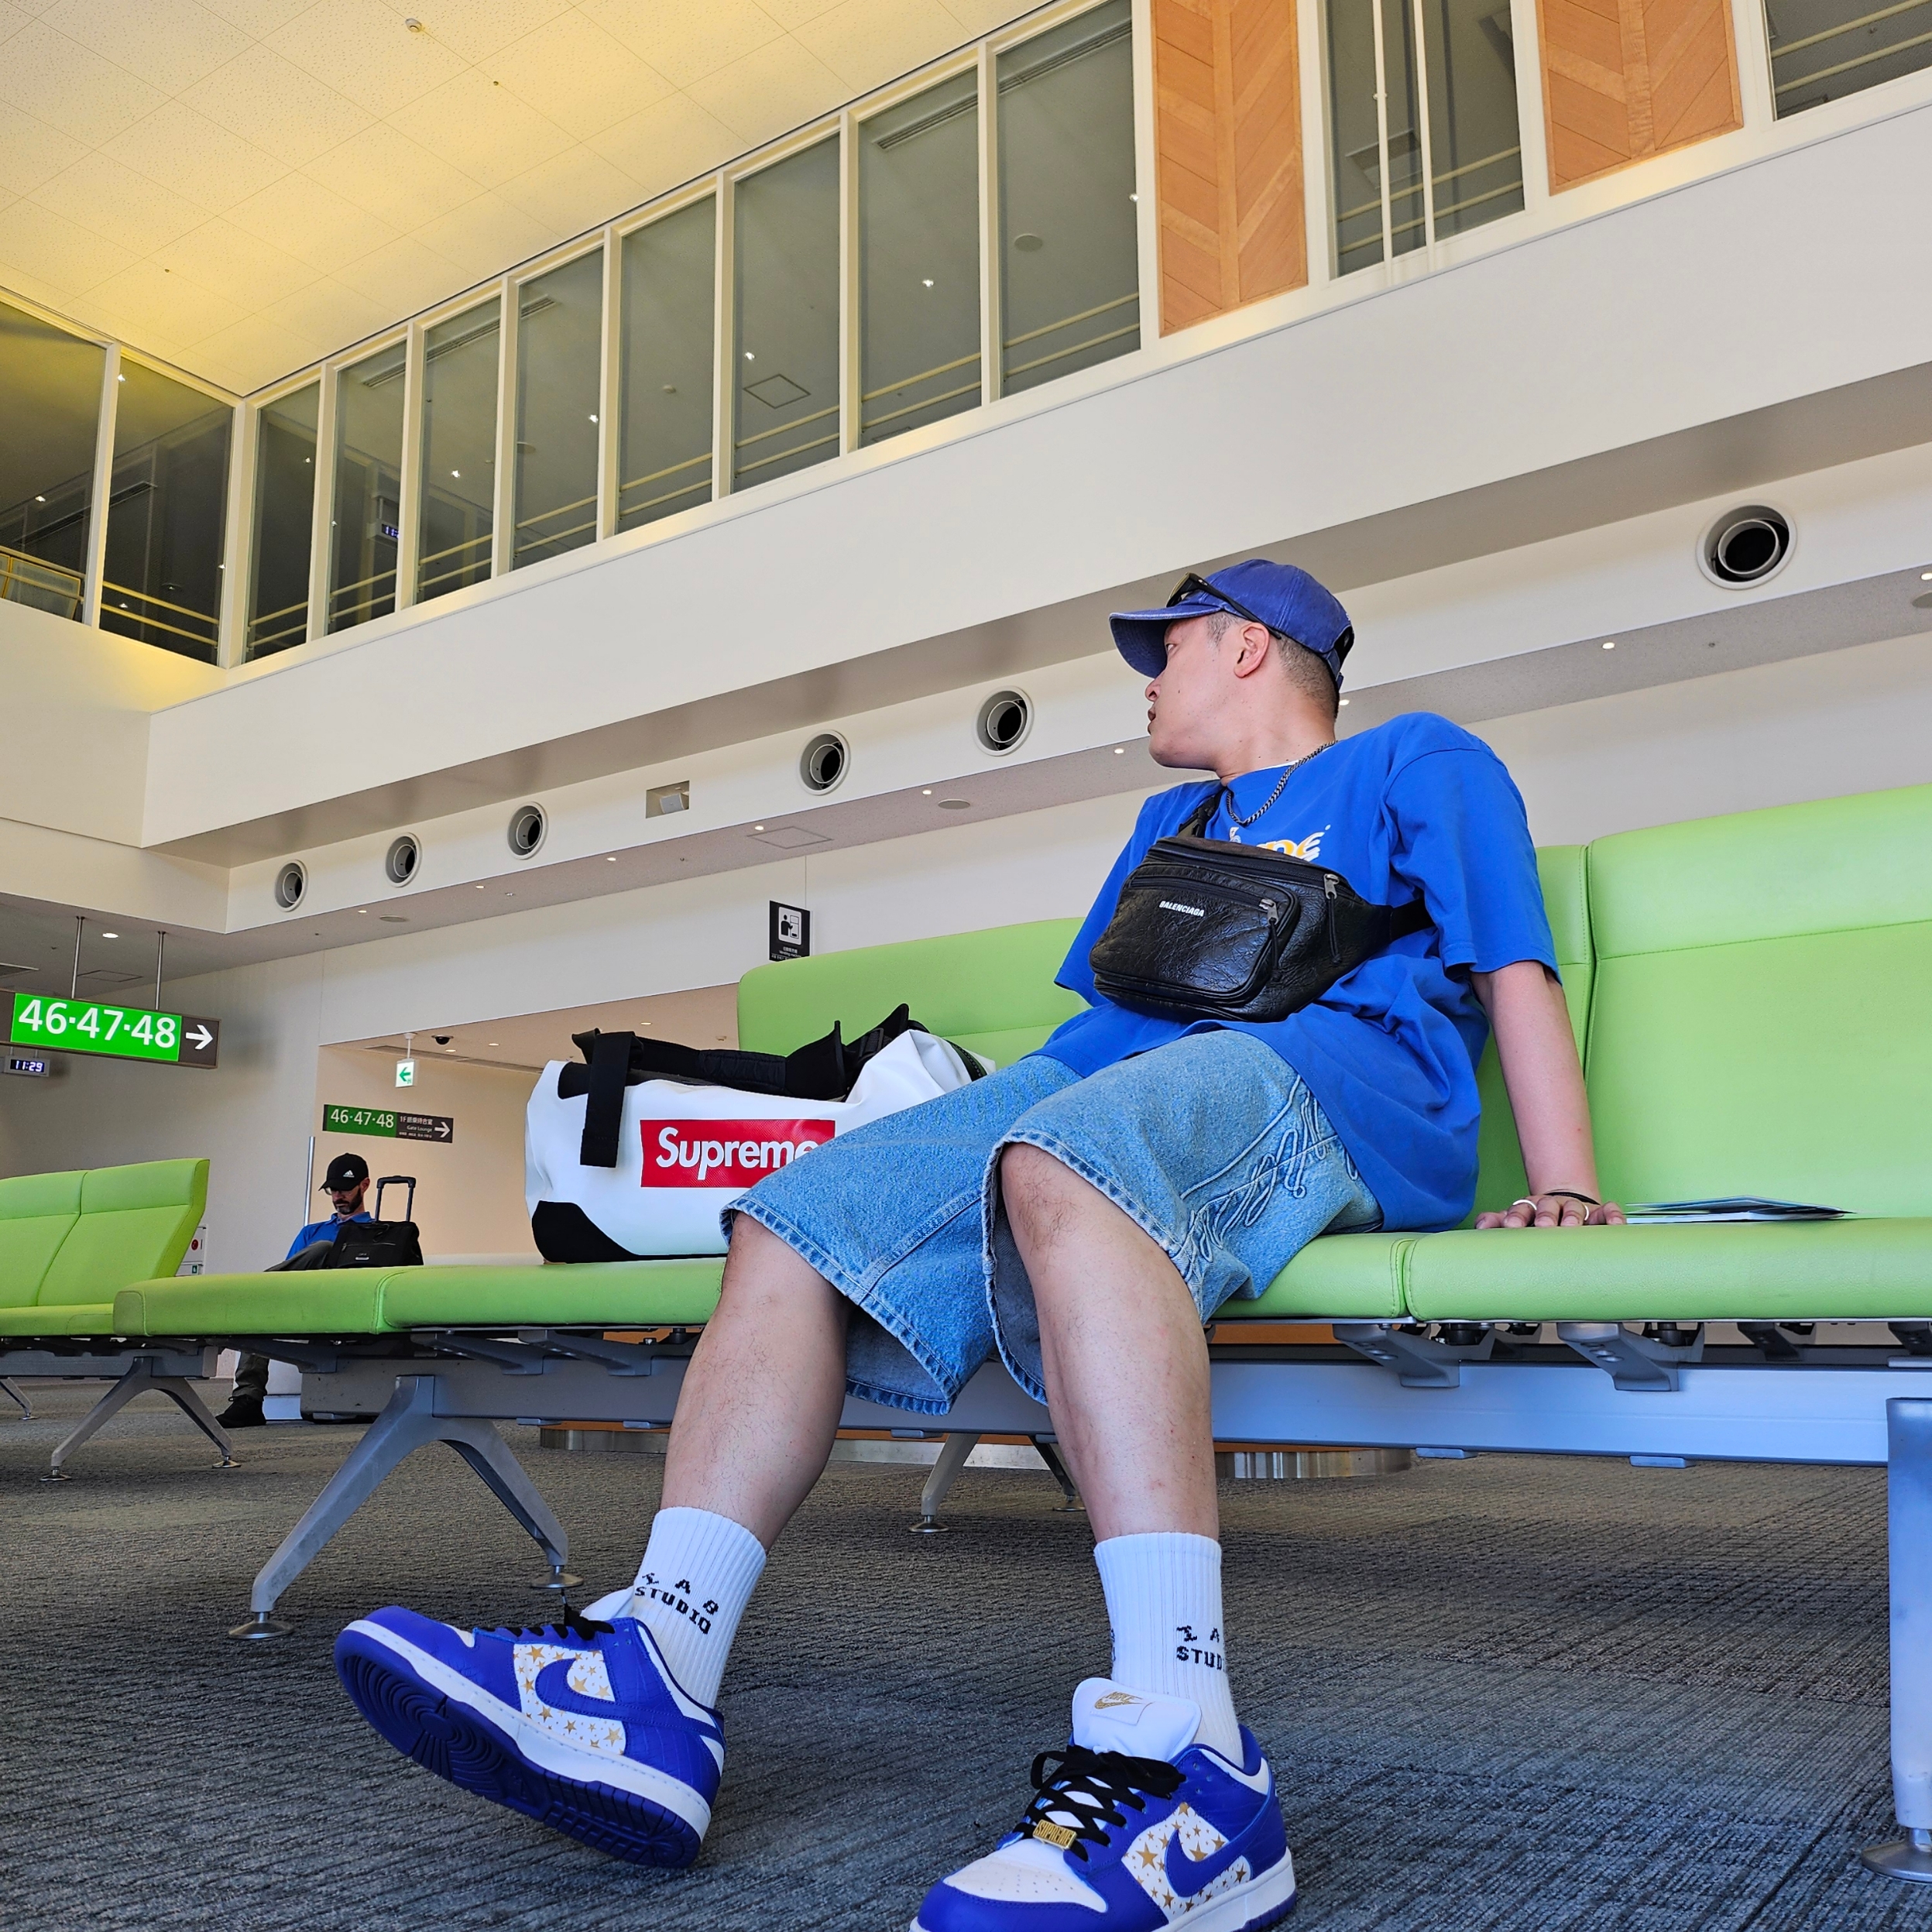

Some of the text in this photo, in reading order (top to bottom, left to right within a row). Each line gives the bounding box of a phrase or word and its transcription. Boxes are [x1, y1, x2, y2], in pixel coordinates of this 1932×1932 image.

[386, 526, 399, 539] 11:
[1158, 900, 1205, 918] BALENCIAGA
[15, 1060, 43, 1072] 11:29
[635, 1586, 712, 1635] STUDIO
[1176, 1645, 1224, 1671] STUD
[1035, 1820, 1075, 1847] SUPREME
